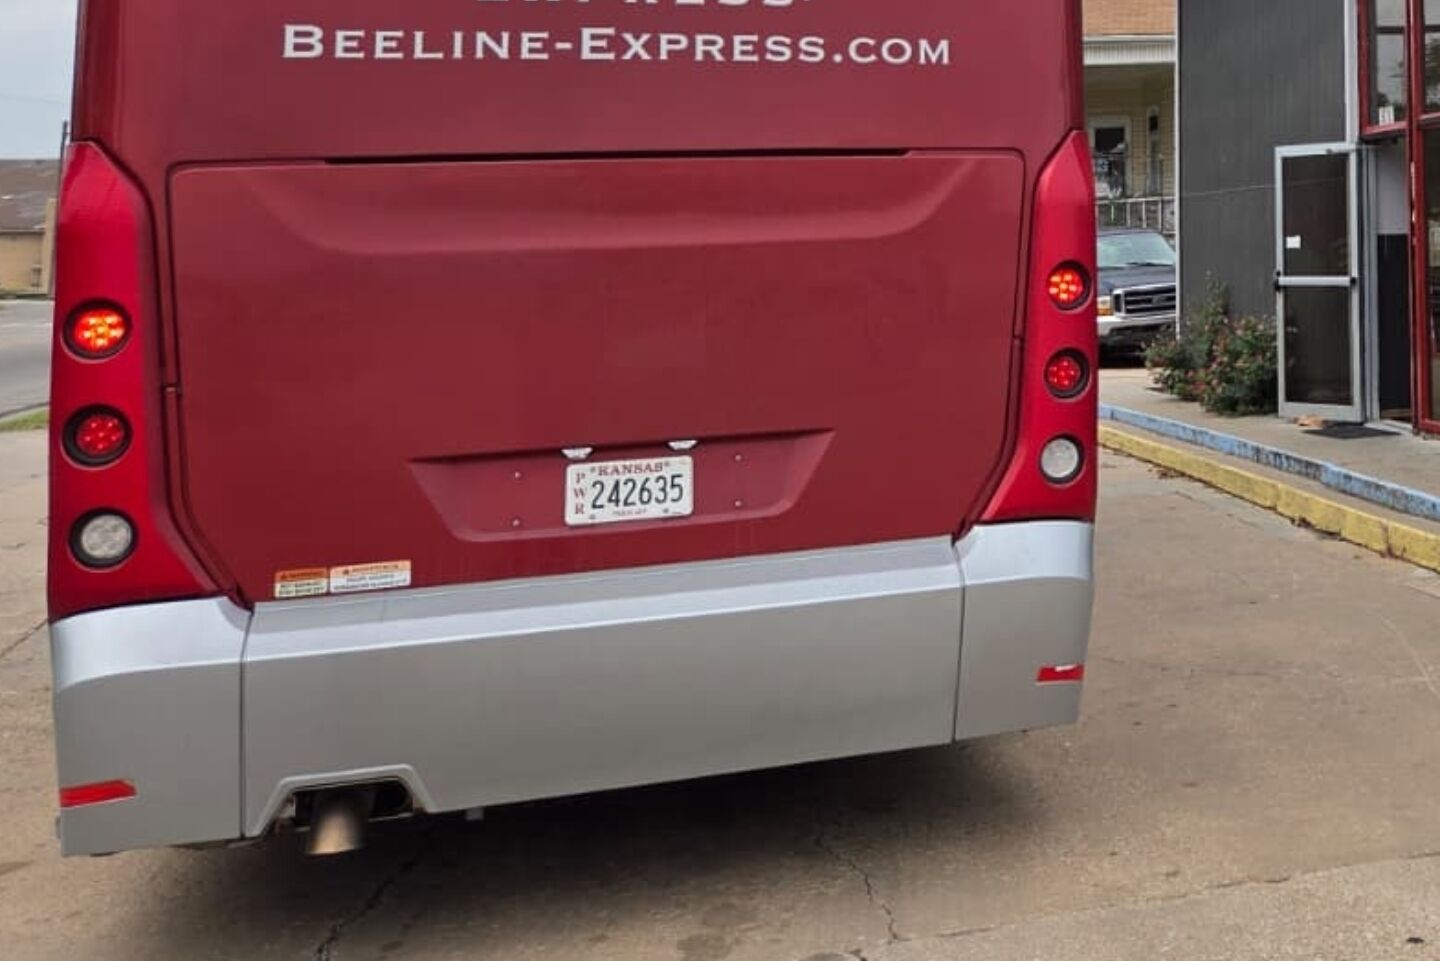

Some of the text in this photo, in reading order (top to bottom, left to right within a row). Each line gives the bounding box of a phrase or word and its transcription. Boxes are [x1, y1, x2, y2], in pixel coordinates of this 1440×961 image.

[281, 23, 951, 65] BEELINE-EXPRESS.COM
[597, 461, 664, 477] KANSAS
[591, 473, 684, 509] 242635
